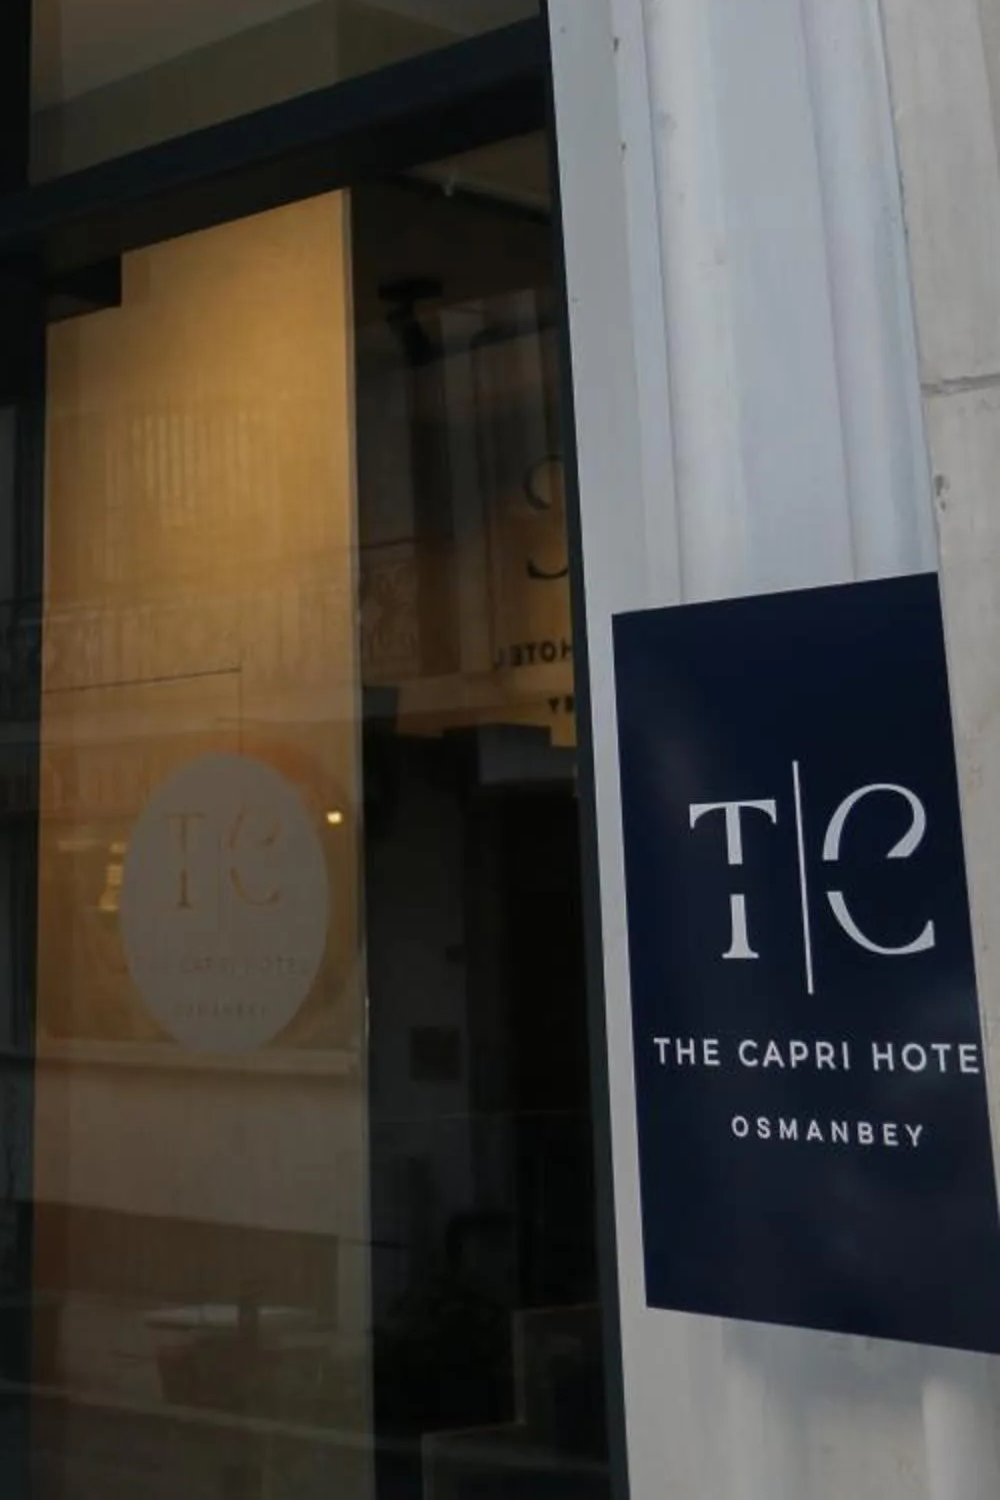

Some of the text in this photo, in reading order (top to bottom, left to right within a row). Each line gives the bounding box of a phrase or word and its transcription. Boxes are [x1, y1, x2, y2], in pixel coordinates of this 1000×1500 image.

[653, 1037, 980, 1074] THE CAPRI HOTE
[731, 1115, 923, 1147] OSMANBEY
